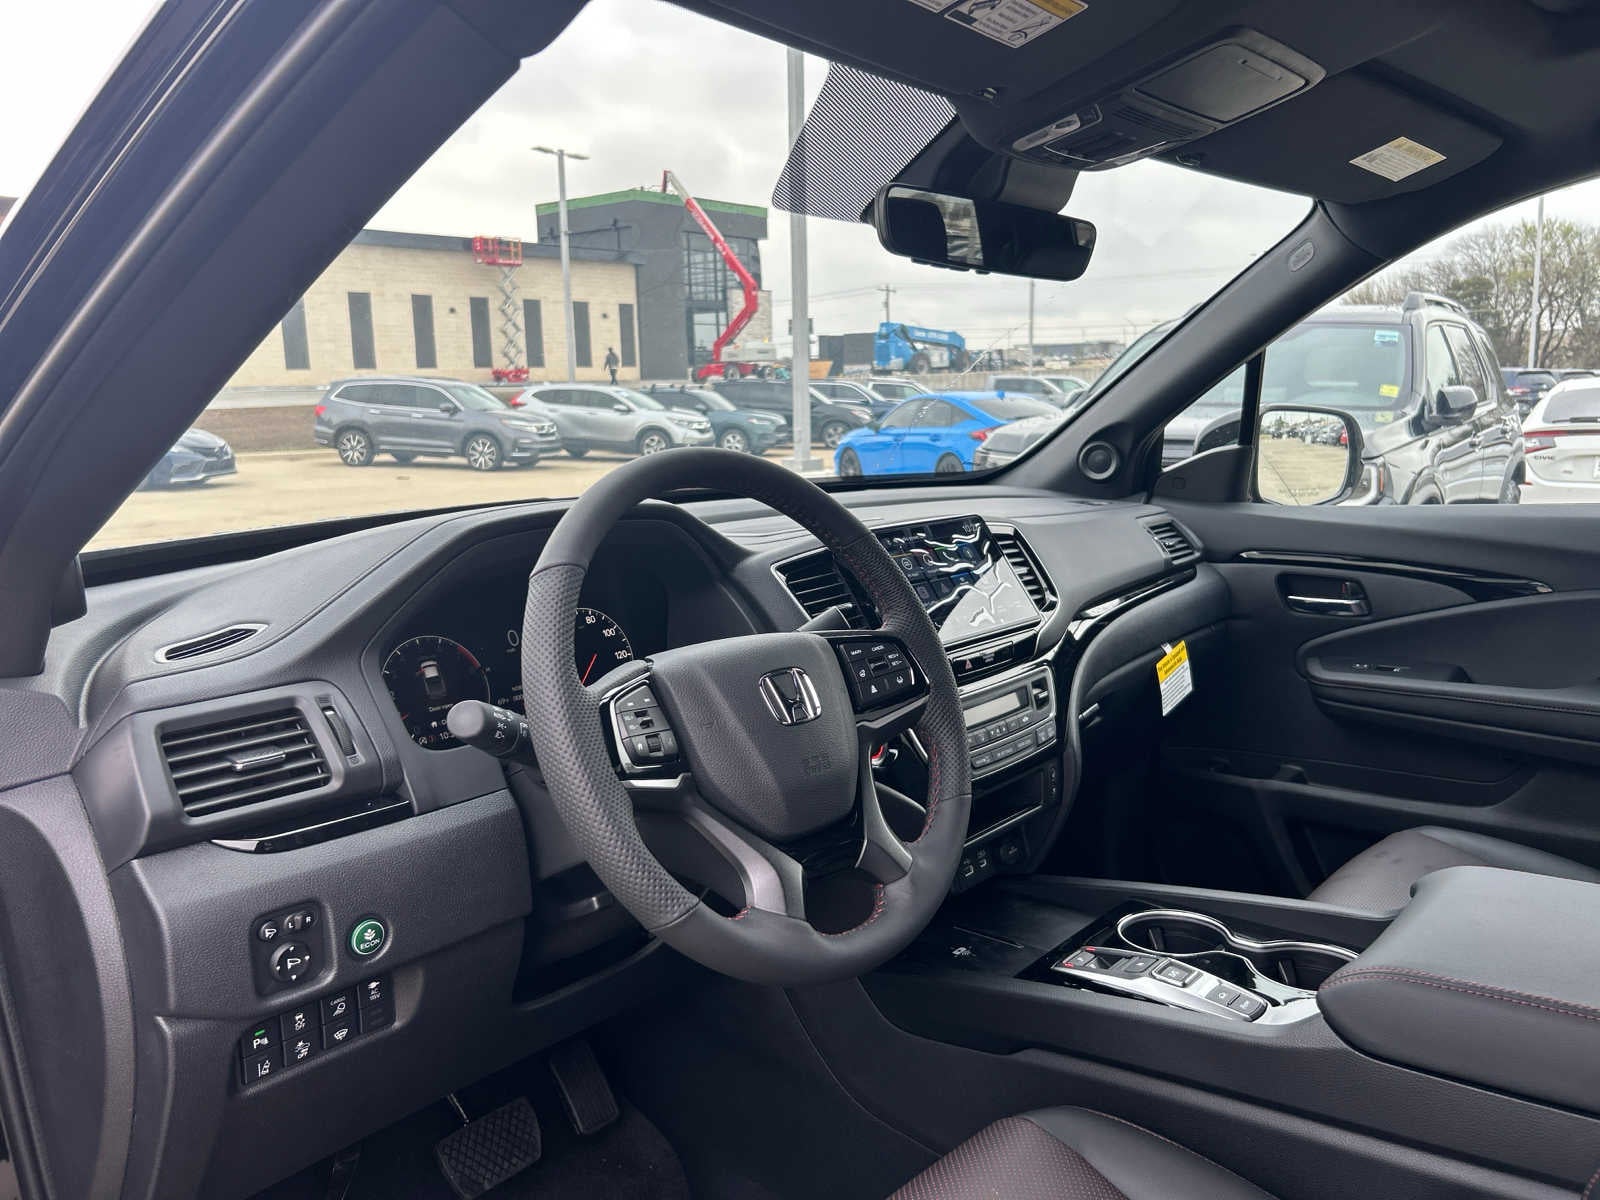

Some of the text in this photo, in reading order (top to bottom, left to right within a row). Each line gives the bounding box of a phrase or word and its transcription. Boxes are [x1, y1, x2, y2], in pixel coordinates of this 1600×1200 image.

[586, 615, 596, 624] 80
[602, 628, 616, 637] 100
[614, 650, 628, 660] 120
[360, 938, 381, 950] ECON
